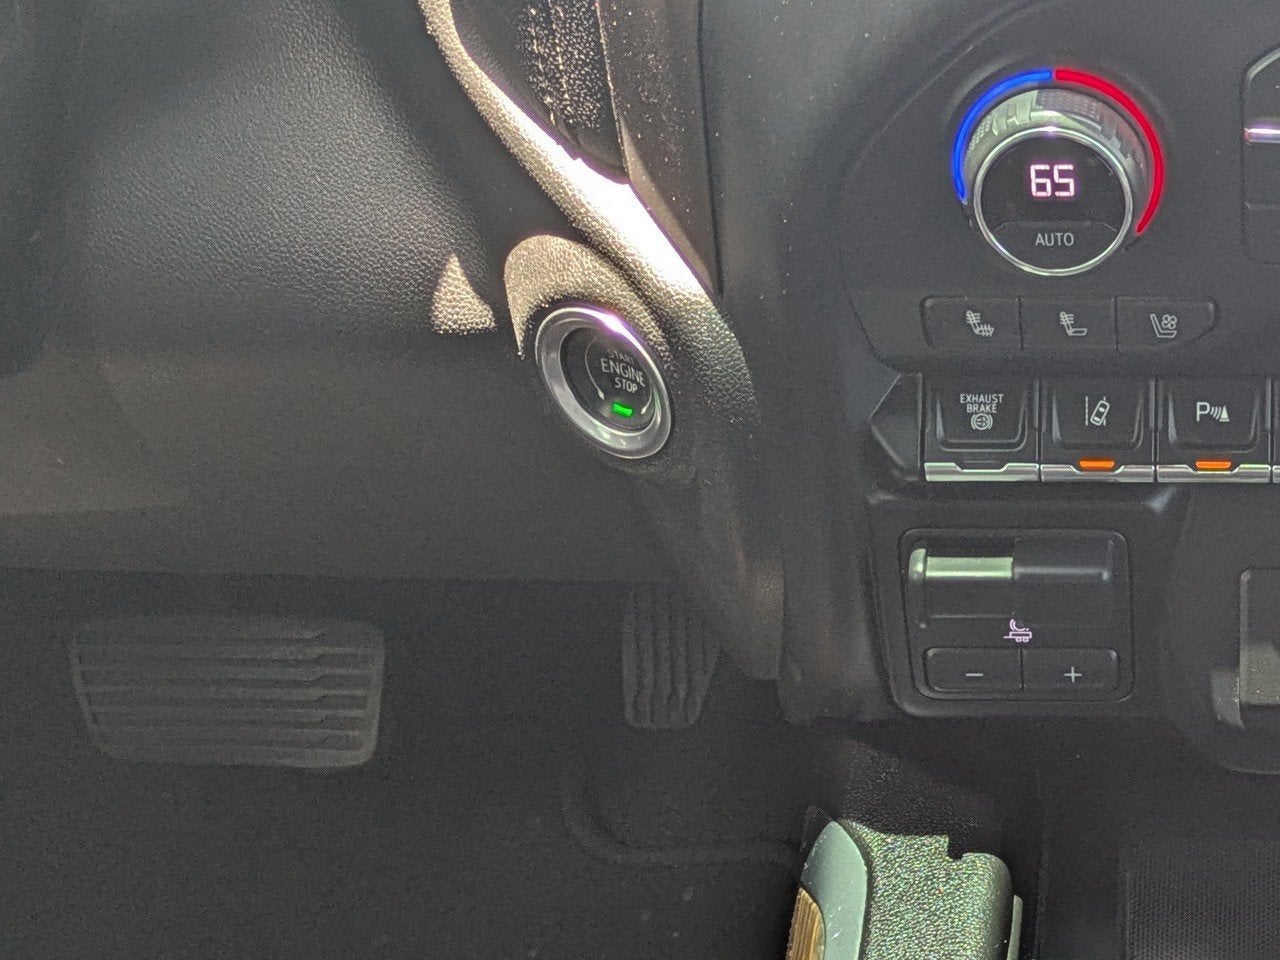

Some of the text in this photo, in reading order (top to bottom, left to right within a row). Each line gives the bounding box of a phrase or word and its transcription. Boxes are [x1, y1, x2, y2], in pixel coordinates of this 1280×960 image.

[1029, 164, 1075, 198] 65
[1034, 232, 1075, 247] AUTO
[600, 358, 646, 388] ENGINE
[614, 379, 639, 394] STOP
[959, 393, 1004, 404] EXHAUST
[965, 403, 998, 414] BRAKE
